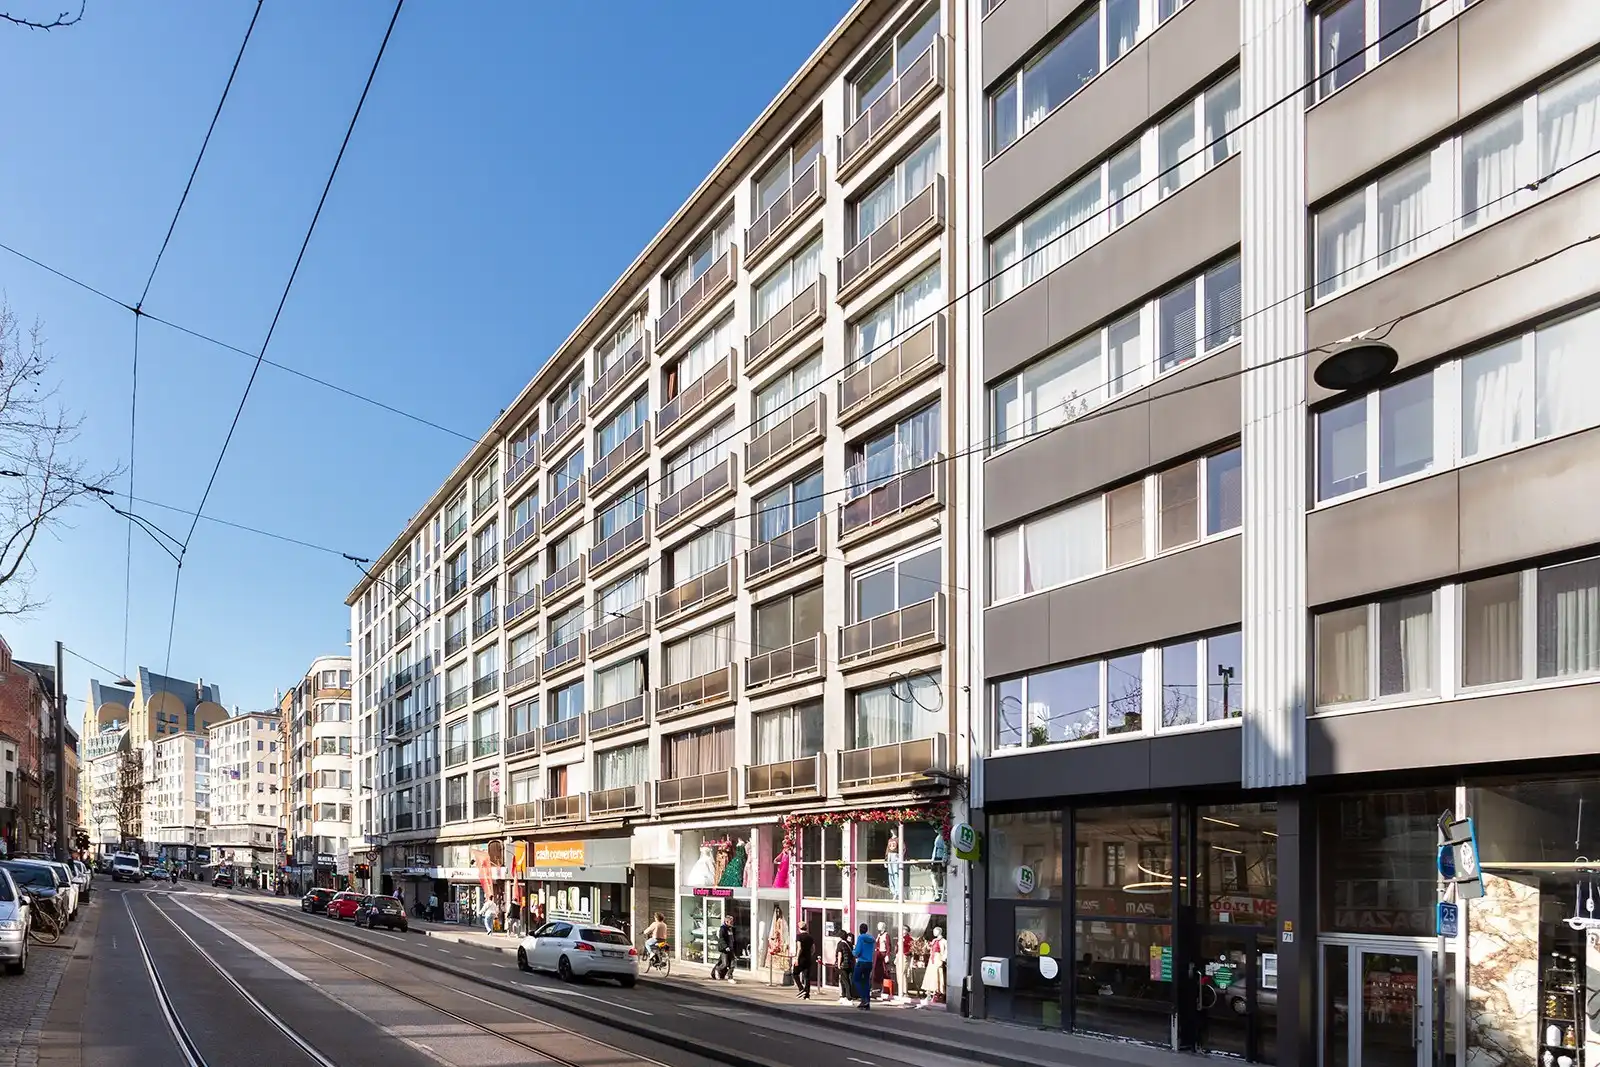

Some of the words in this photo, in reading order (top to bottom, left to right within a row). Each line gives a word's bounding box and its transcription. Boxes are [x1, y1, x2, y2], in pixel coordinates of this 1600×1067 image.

[536, 845, 550, 860] cash
[550, 848, 584, 860] converters
[693, 888, 709, 896] Today
[1443, 908, 1456, 922] 25
[1283, 932, 1292, 941] 71
